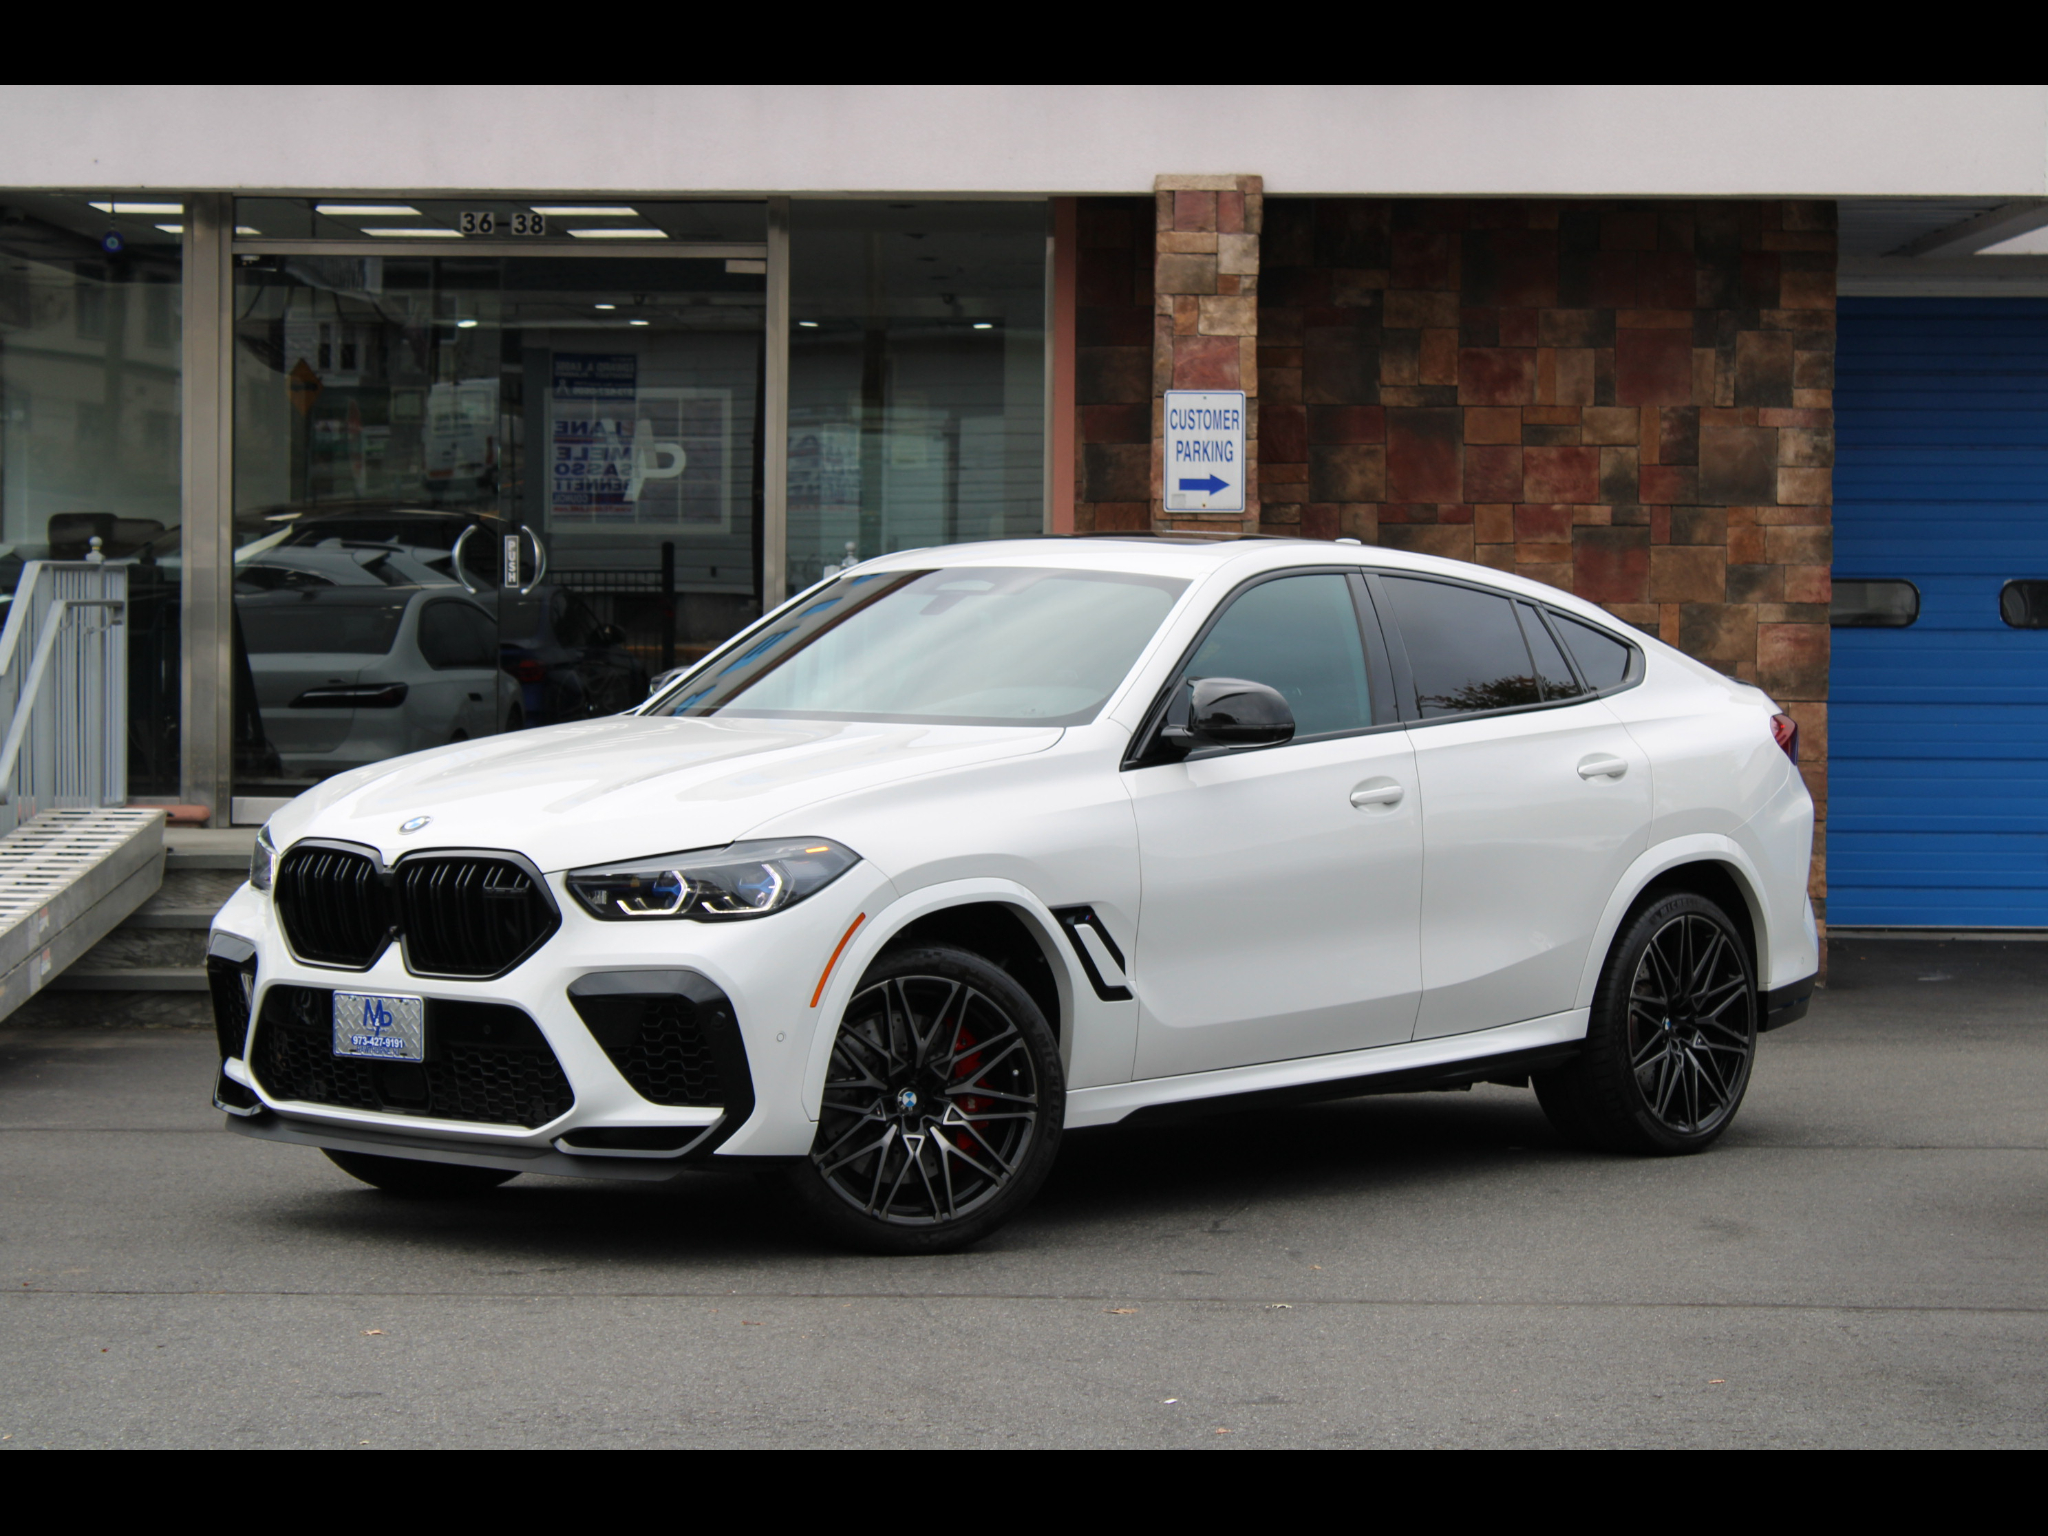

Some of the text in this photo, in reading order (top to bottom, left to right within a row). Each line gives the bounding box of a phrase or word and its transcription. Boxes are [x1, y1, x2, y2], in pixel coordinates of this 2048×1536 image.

[462, 213, 543, 234] 36-38
[1169, 408, 1240, 431] CUSTOMER
[1176, 440, 1234, 463] PARKING
[507, 540, 517, 583] PUSH
[352, 1035, 405, 1049] 973-427-9191
